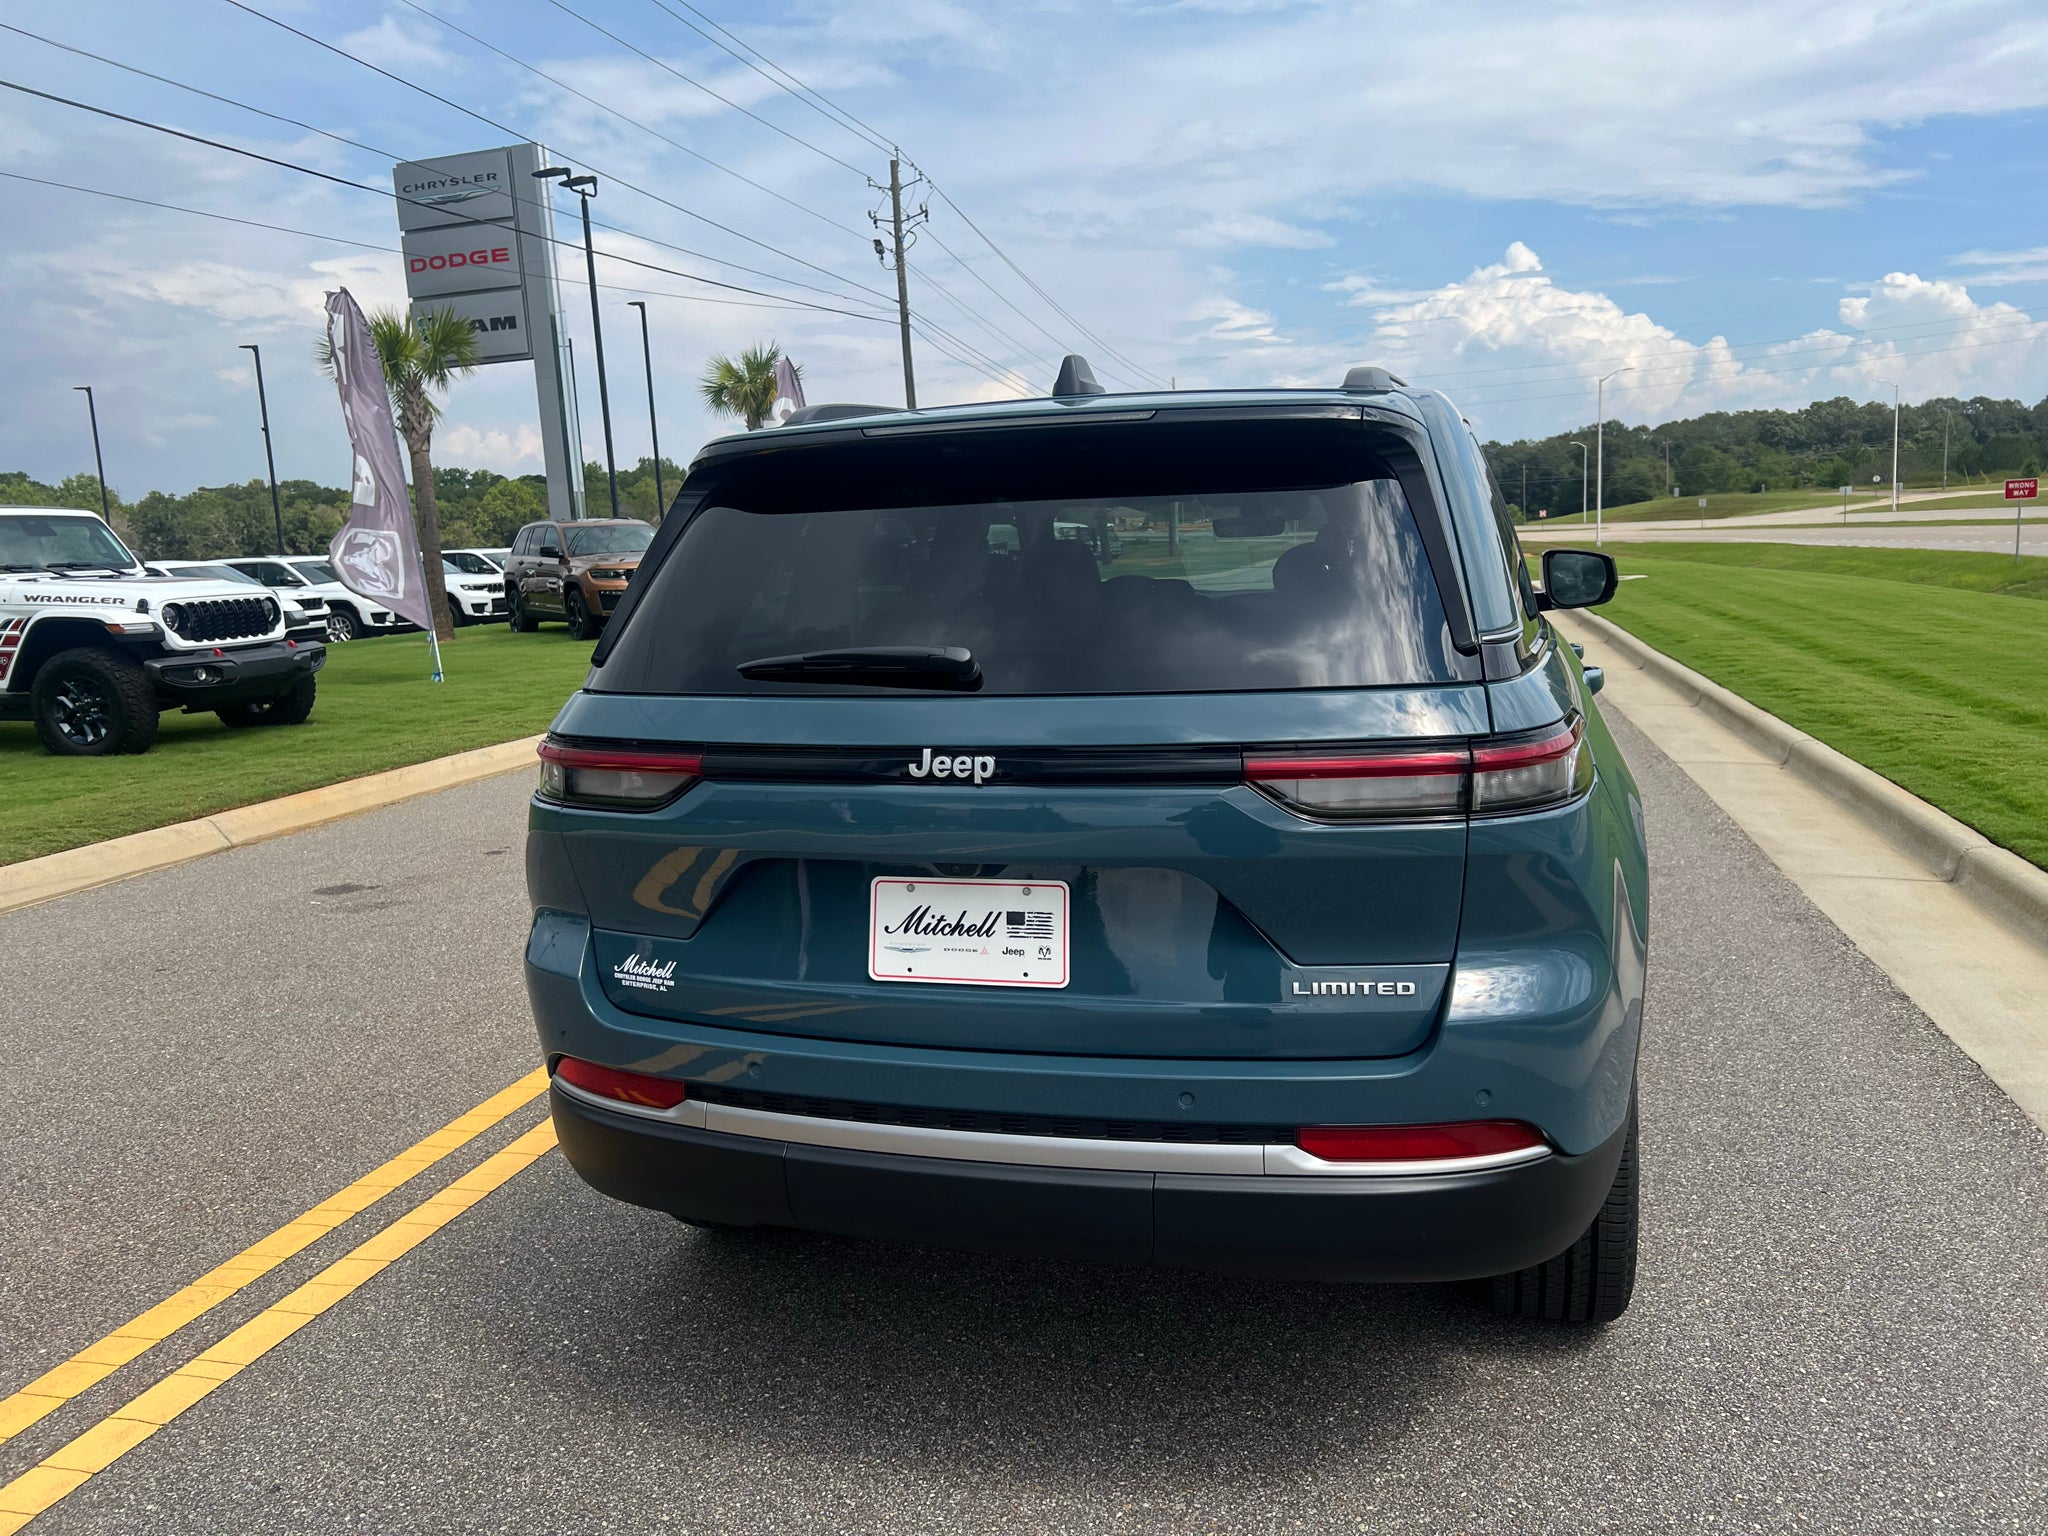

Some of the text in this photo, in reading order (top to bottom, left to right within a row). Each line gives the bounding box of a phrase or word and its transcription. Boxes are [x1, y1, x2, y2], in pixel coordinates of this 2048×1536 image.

[402, 172, 498, 193] CHRYSLER
[410, 247, 510, 273] DODGE
[453, 315, 517, 333] AM
[2008, 481, 2035, 489] WRONG
[24, 594, 125, 605] WRANGLER
[908, 748, 995, 784] Jeep
[884, 904, 1003, 938] Mitchell
[1002, 946, 1025, 957] Jeep
[614, 953, 677, 978] Mitchell
[1293, 981, 1416, 995] LIMITED
